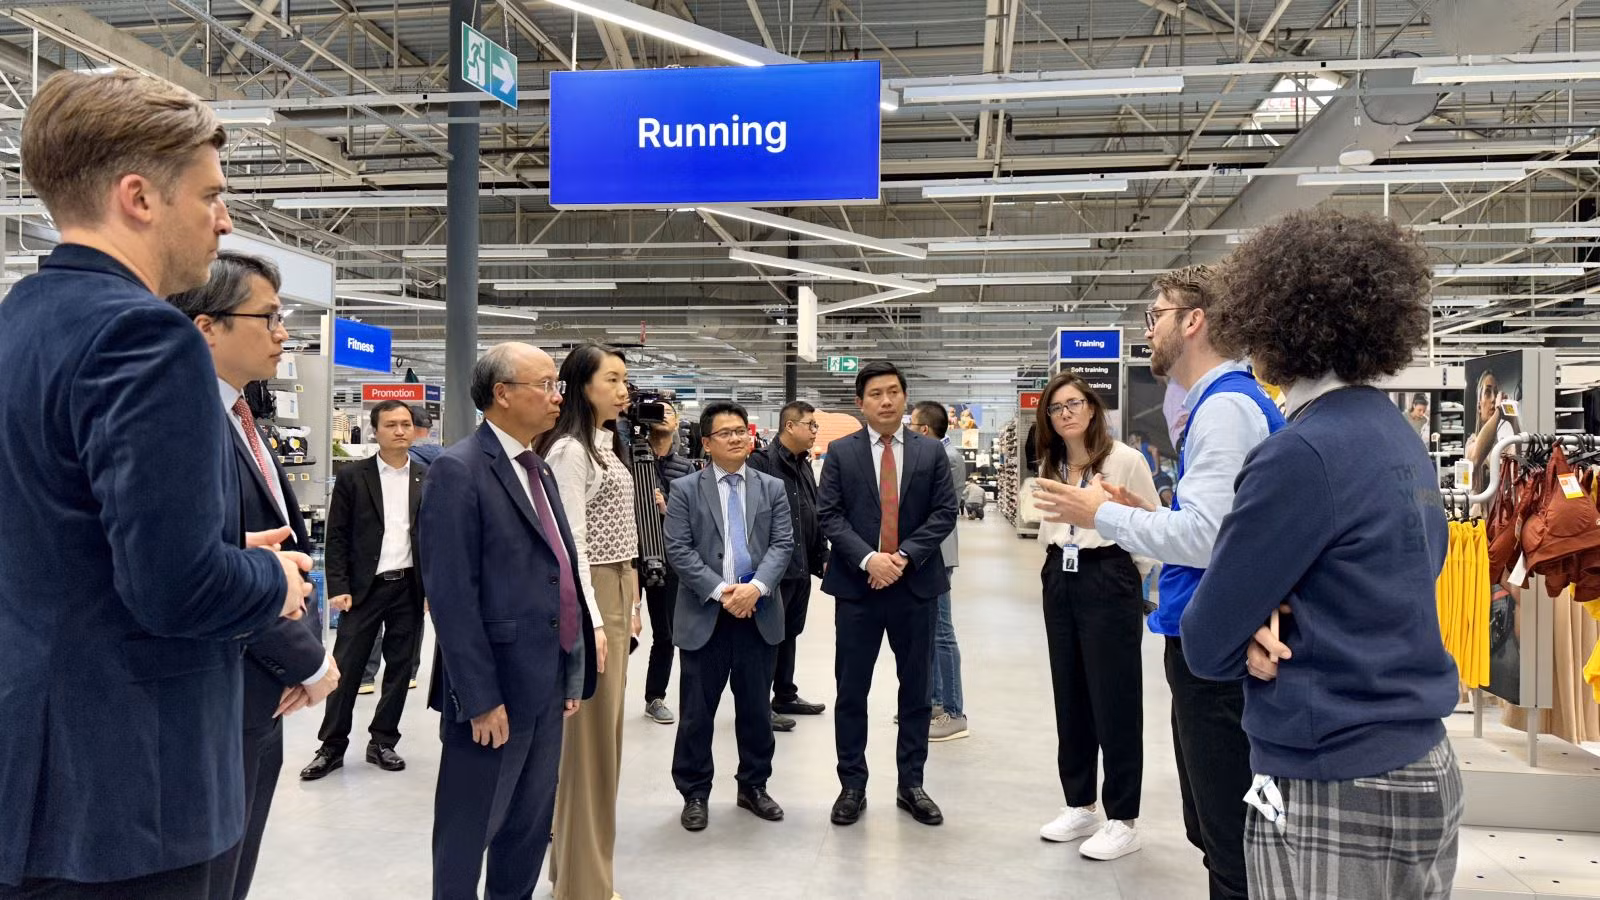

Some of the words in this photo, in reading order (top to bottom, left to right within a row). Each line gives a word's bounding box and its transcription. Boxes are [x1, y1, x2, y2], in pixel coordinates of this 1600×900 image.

[638, 113, 788, 154] Running
[347, 337, 375, 353] Fitness
[1074, 339, 1105, 349] Training
[1084, 366, 1109, 374] training
[371, 388, 415, 398] Promotion
